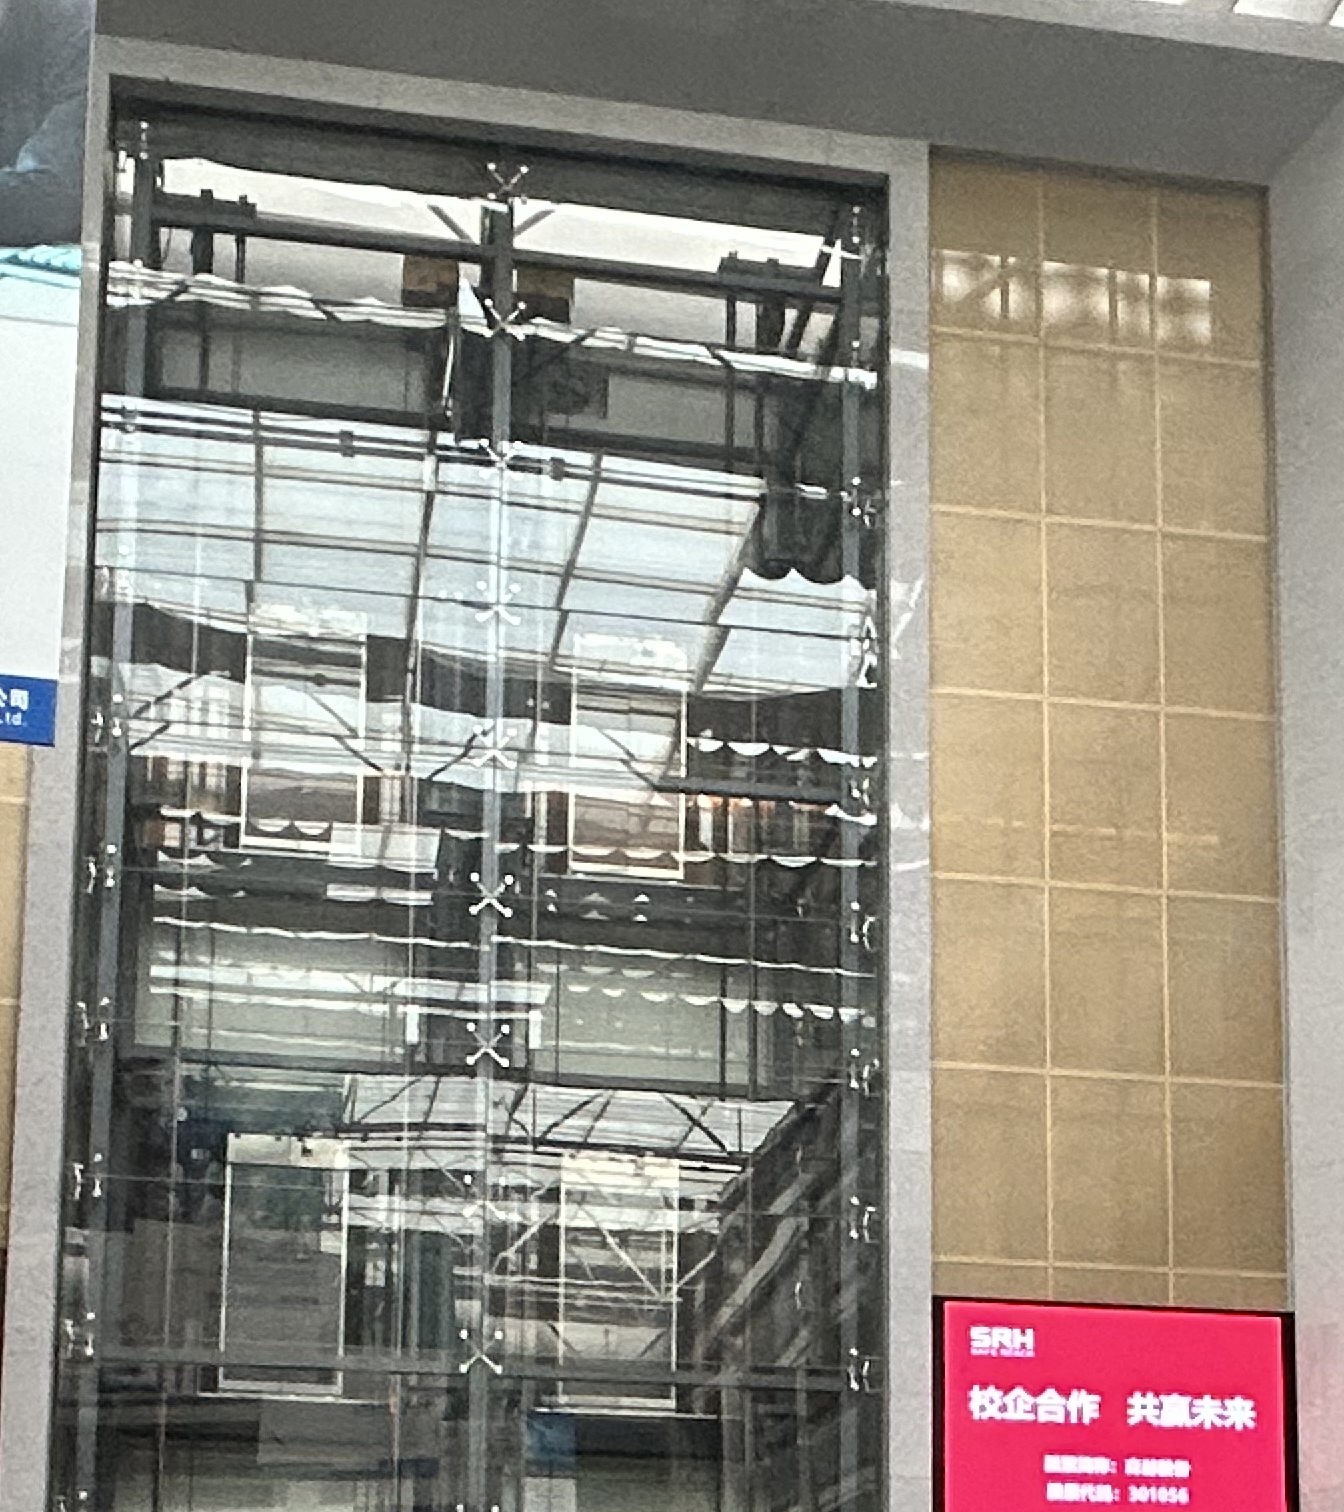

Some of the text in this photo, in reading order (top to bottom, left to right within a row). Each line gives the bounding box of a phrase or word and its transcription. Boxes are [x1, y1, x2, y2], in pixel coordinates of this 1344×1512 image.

[969, 1325, 1035, 1349] SRH
[967, 1383, 1256, 1431] 校企合作 共赢未来
